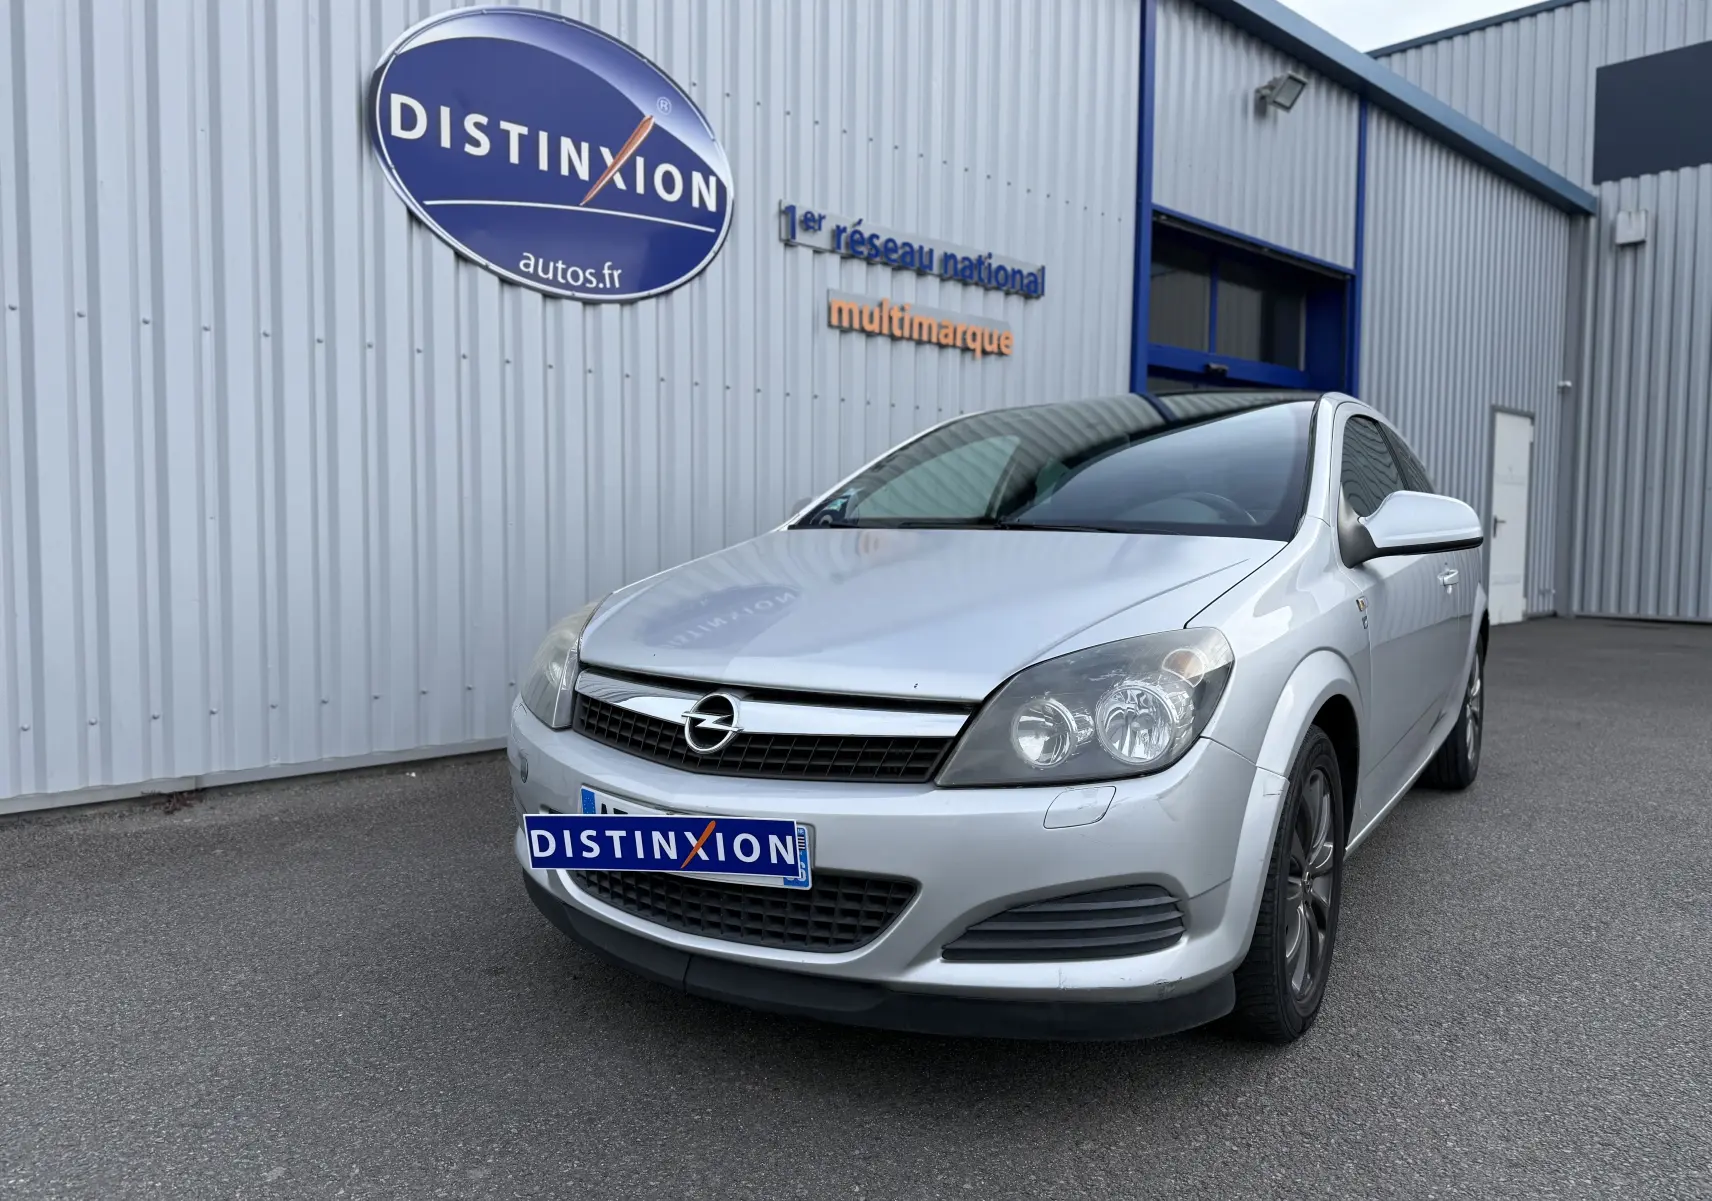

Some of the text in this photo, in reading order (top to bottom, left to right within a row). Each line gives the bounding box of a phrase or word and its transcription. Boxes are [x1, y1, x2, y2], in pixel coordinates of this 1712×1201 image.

[390, 92, 717, 212] DISTINXION
[518, 251, 623, 290] autos.fr
[783, 204, 1046, 297] 1er réseau national
[830, 297, 1014, 359] multimarque
